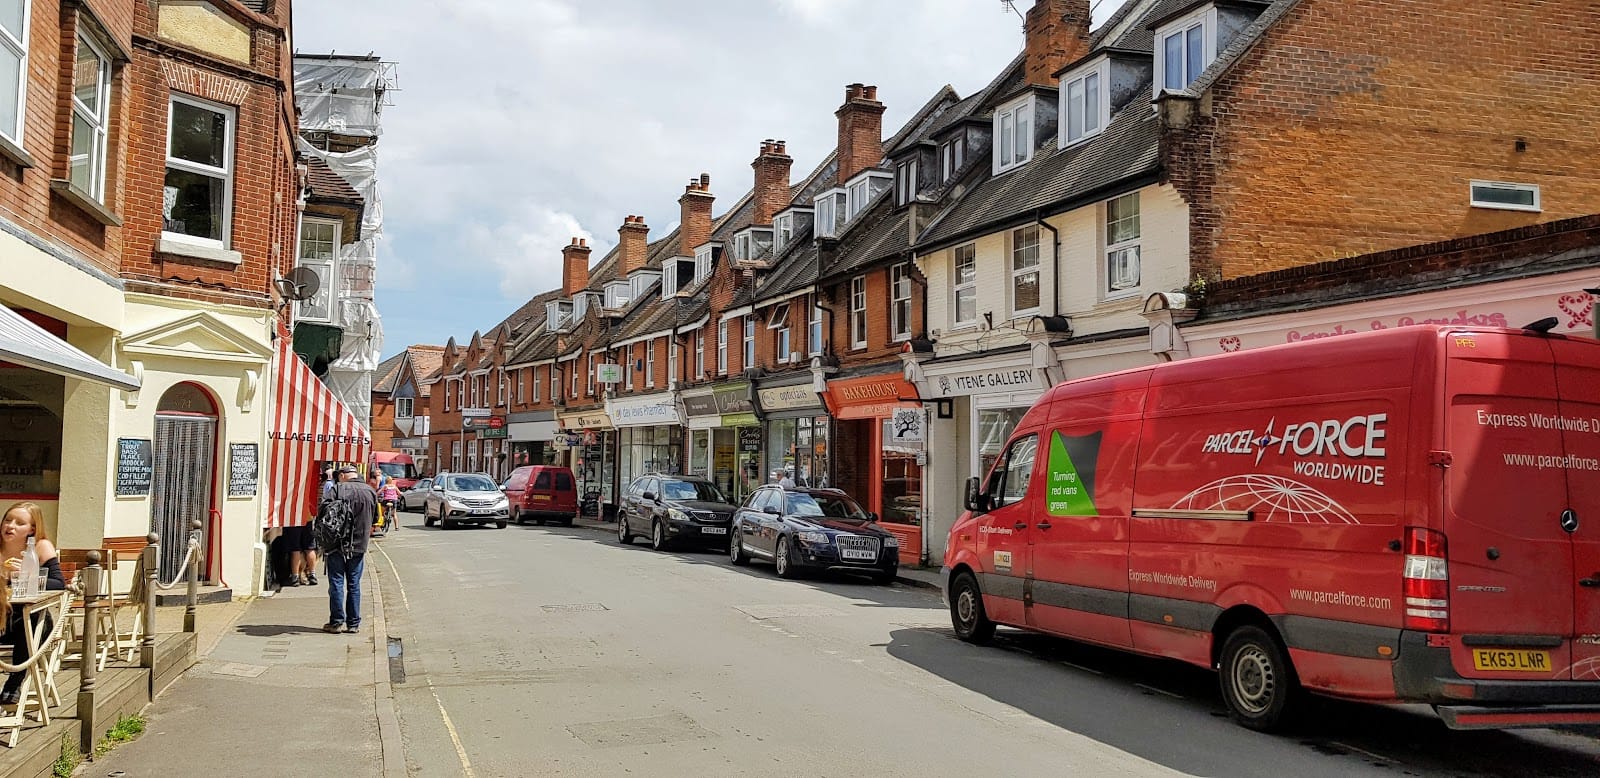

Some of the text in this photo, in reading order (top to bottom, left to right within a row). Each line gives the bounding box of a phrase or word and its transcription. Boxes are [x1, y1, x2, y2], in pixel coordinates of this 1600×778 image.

[954, 369, 1033, 390] YTENE GALLERY
[843, 382, 899, 400] BAKEHOUSE
[1477, 409, 1527, 428] Express
[1529, 412, 1590, 432] Worldwide
[268, 431, 370, 445] VILLAGE BUTCHERS
[1202, 413, 1387, 458] PARCEL FORCE
[1053, 471, 1076, 482] Turning
[1294, 461, 1385, 486] WORLDWIDE
[1051, 486, 1078, 495] red vans
[1050, 501, 1067, 511] green
[1128, 569, 1217, 592] Express Worldwide Delivery
[1289, 588, 1391, 609] www.parcelforce.com
[1480, 651, 1545, 669] EK63 LNR
